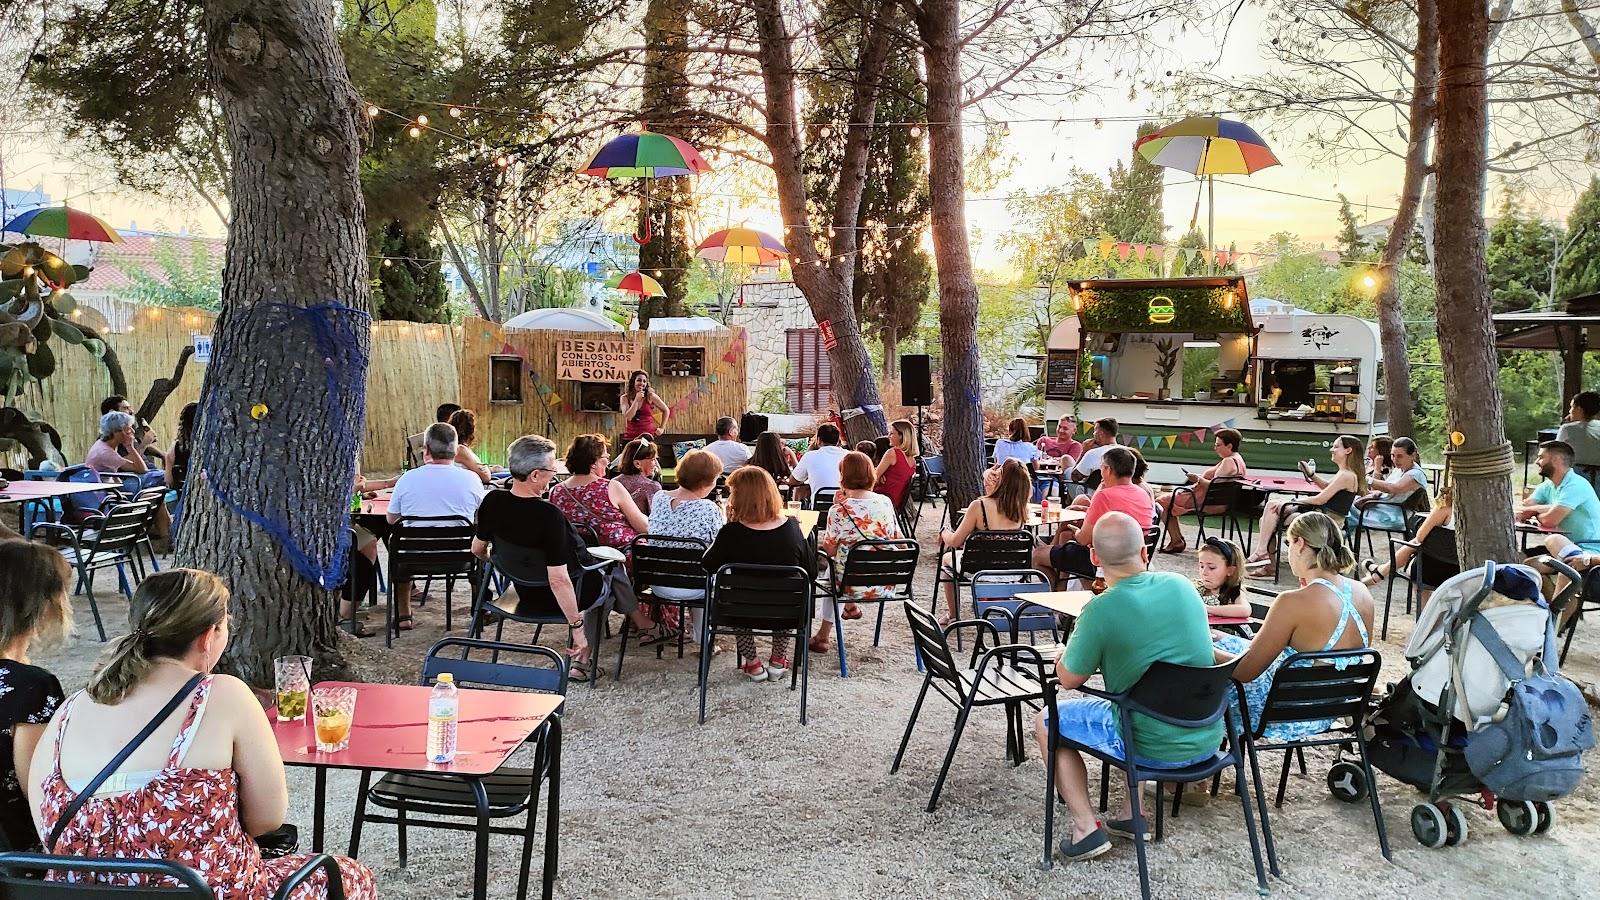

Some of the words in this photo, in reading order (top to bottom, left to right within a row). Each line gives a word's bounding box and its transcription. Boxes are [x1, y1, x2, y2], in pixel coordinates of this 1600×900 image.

[561, 340, 635, 354] BESAME
[561, 352, 583, 360] CON
[561, 360, 610, 368] ABIERTOS
[561, 368, 572, 378] A
